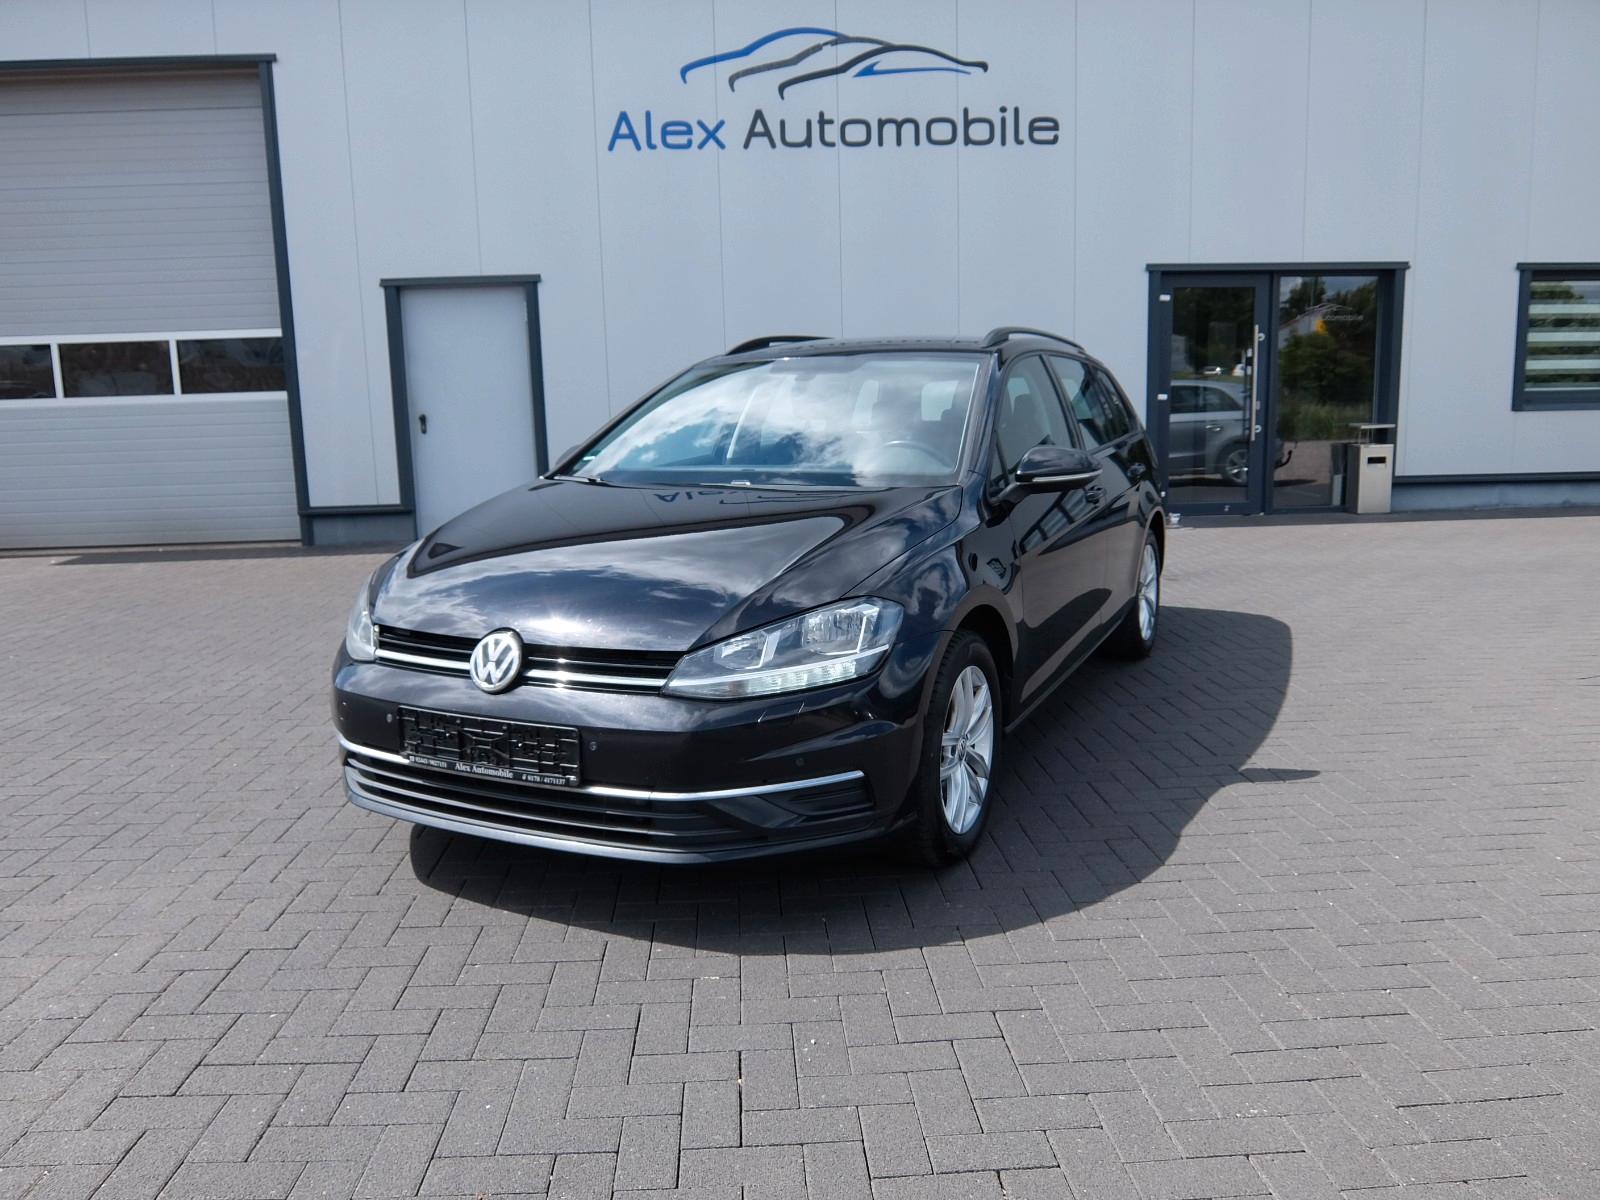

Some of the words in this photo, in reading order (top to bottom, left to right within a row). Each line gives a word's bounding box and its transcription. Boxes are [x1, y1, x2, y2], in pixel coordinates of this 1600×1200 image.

[608, 109, 726, 152] Alex
[742, 105, 1060, 150] Automobile
[455, 762, 471, 772] Alex
[472, 765, 514, 779] Automobile
